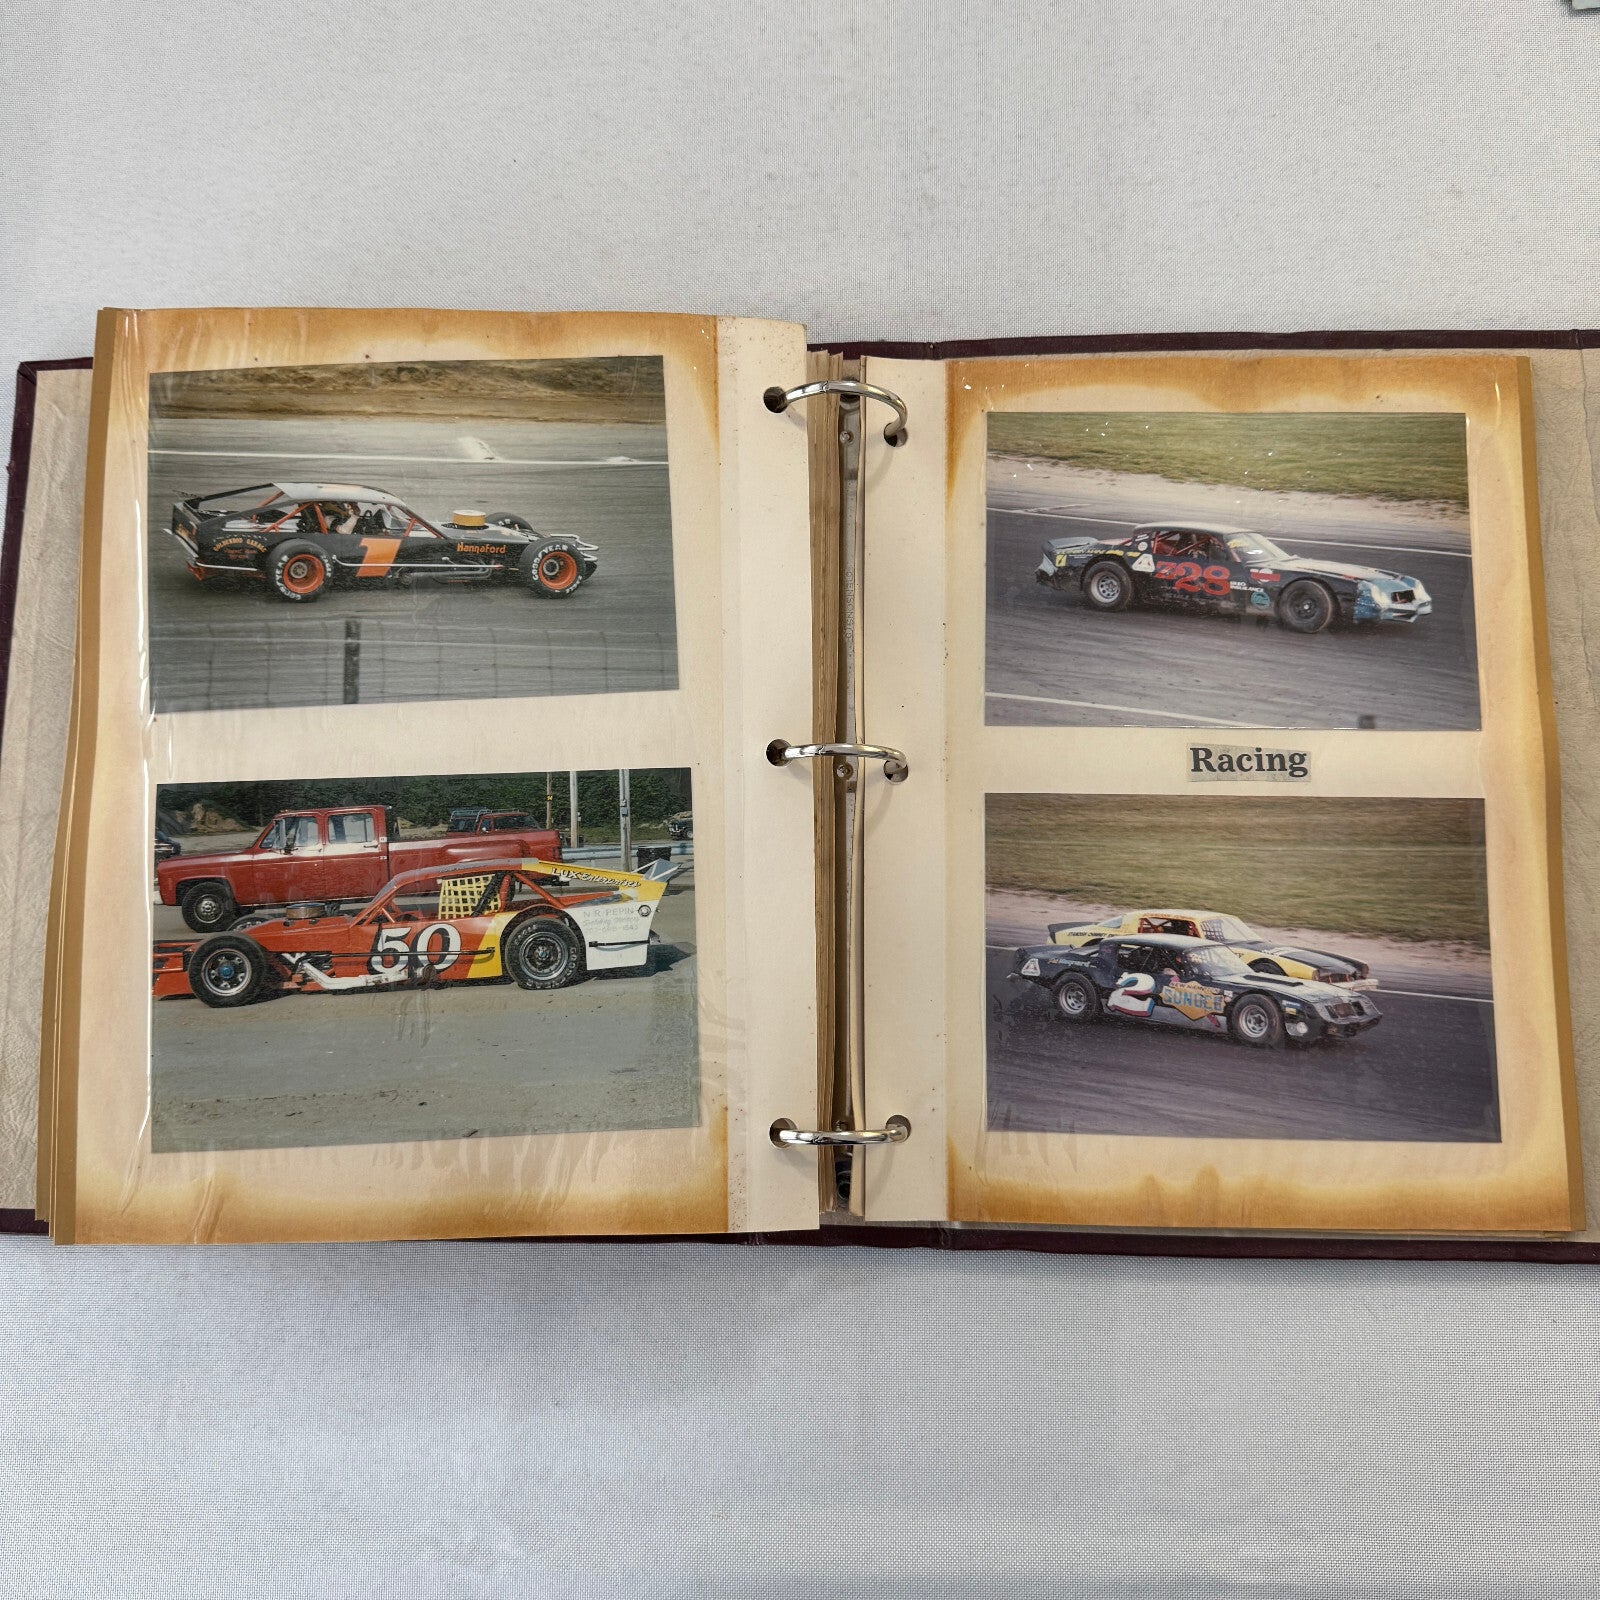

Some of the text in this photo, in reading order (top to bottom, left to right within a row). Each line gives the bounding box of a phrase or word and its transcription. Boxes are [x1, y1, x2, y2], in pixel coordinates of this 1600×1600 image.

[356, 537, 402, 577] 1
[532, 544, 568, 580] GOODYEAR
[1190, 747, 1309, 778] Racing
[370, 923, 461, 974] 50
[1116, 972, 1155, 1017] 2
